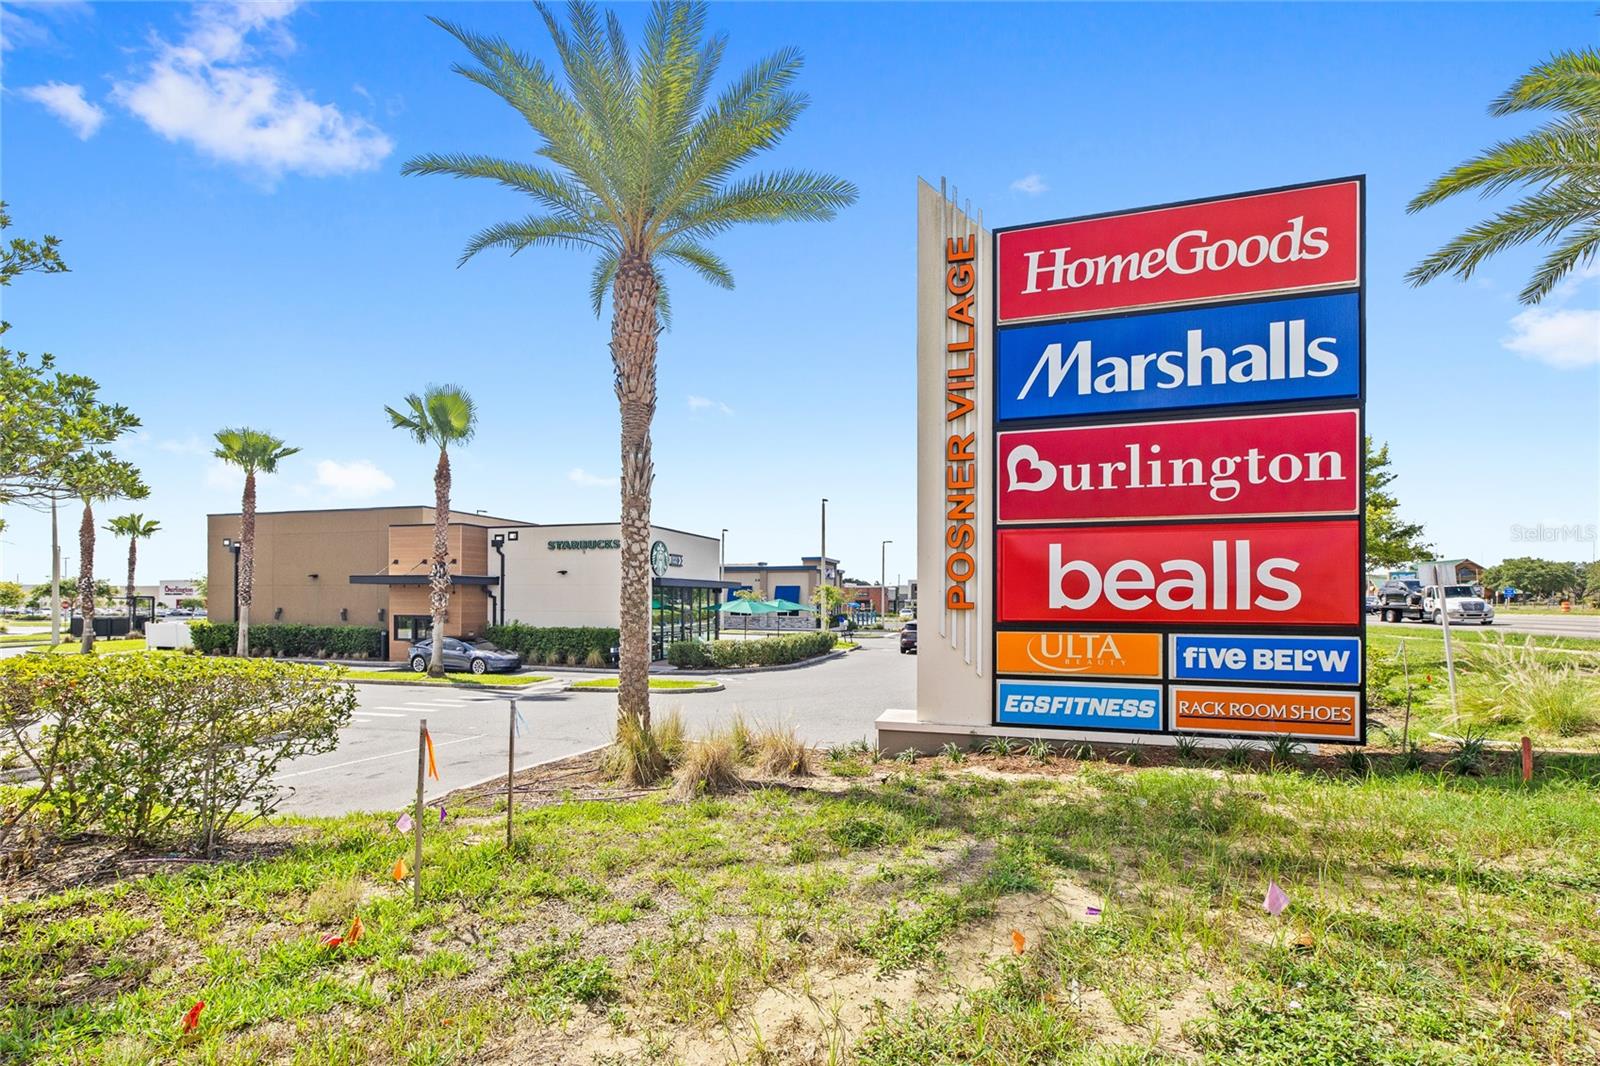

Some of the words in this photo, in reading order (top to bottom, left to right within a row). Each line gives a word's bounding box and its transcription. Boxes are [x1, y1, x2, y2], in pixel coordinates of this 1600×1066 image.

[1021, 216, 1329, 294] HomeGoods
[947, 234, 975, 421] VILLAGE
[1017, 319, 1339, 400] Marshalls
[1007, 443, 1346, 502] Burlington
[547, 539, 620, 551] STARBUCKS
[946, 432, 975, 610] POSNER
[1049, 539, 1302, 611] bealls
[1040, 633, 1122, 659] ULTA
[1064, 658, 1128, 666] BEAUTY
[1183, 646, 1247, 670] five
[1179, 700, 1226, 716] RACK
[1229, 703, 1287, 719] ROOM
[1290, 704, 1352, 722] SHOES
